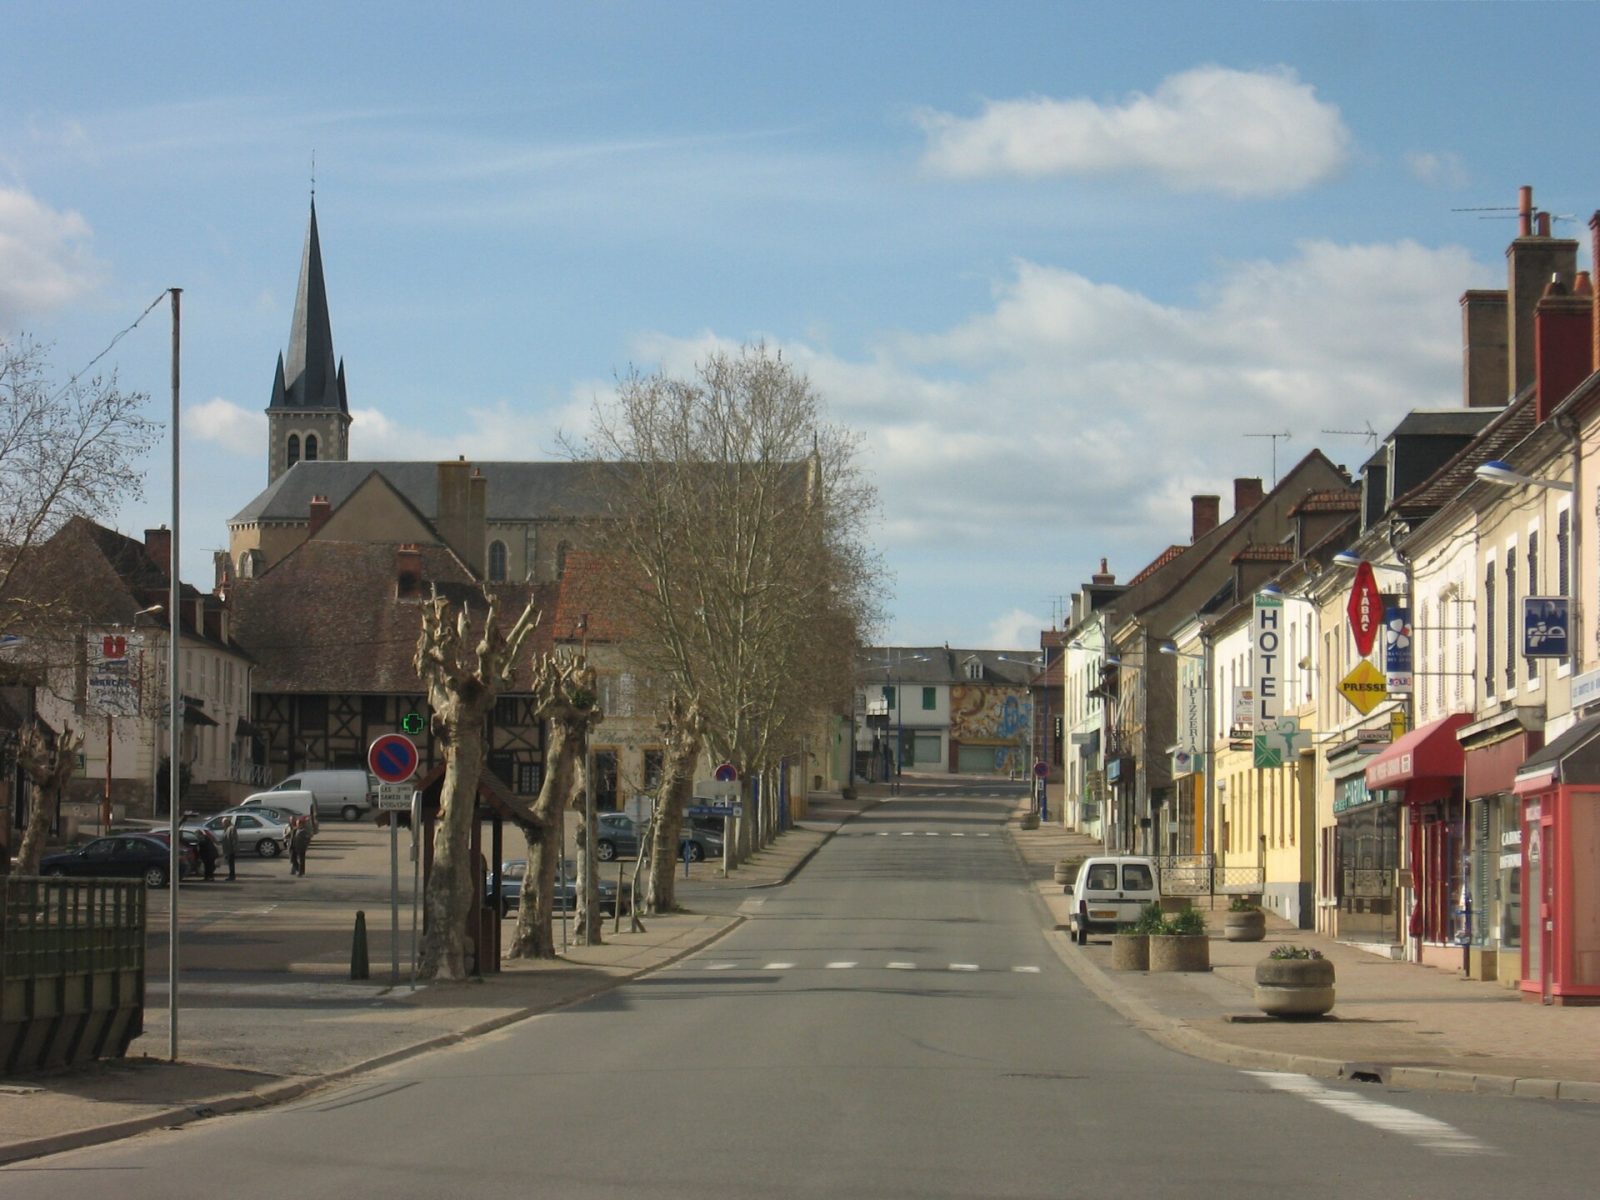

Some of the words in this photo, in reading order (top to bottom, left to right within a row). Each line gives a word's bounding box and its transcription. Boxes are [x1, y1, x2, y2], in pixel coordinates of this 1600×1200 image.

[1360, 588, 1370, 632] TABAC
[1259, 609, 1279, 720] HOTEL
[1343, 683, 1387, 692] PRESSE
[1188, 688, 1198, 753] PIZZERIA
